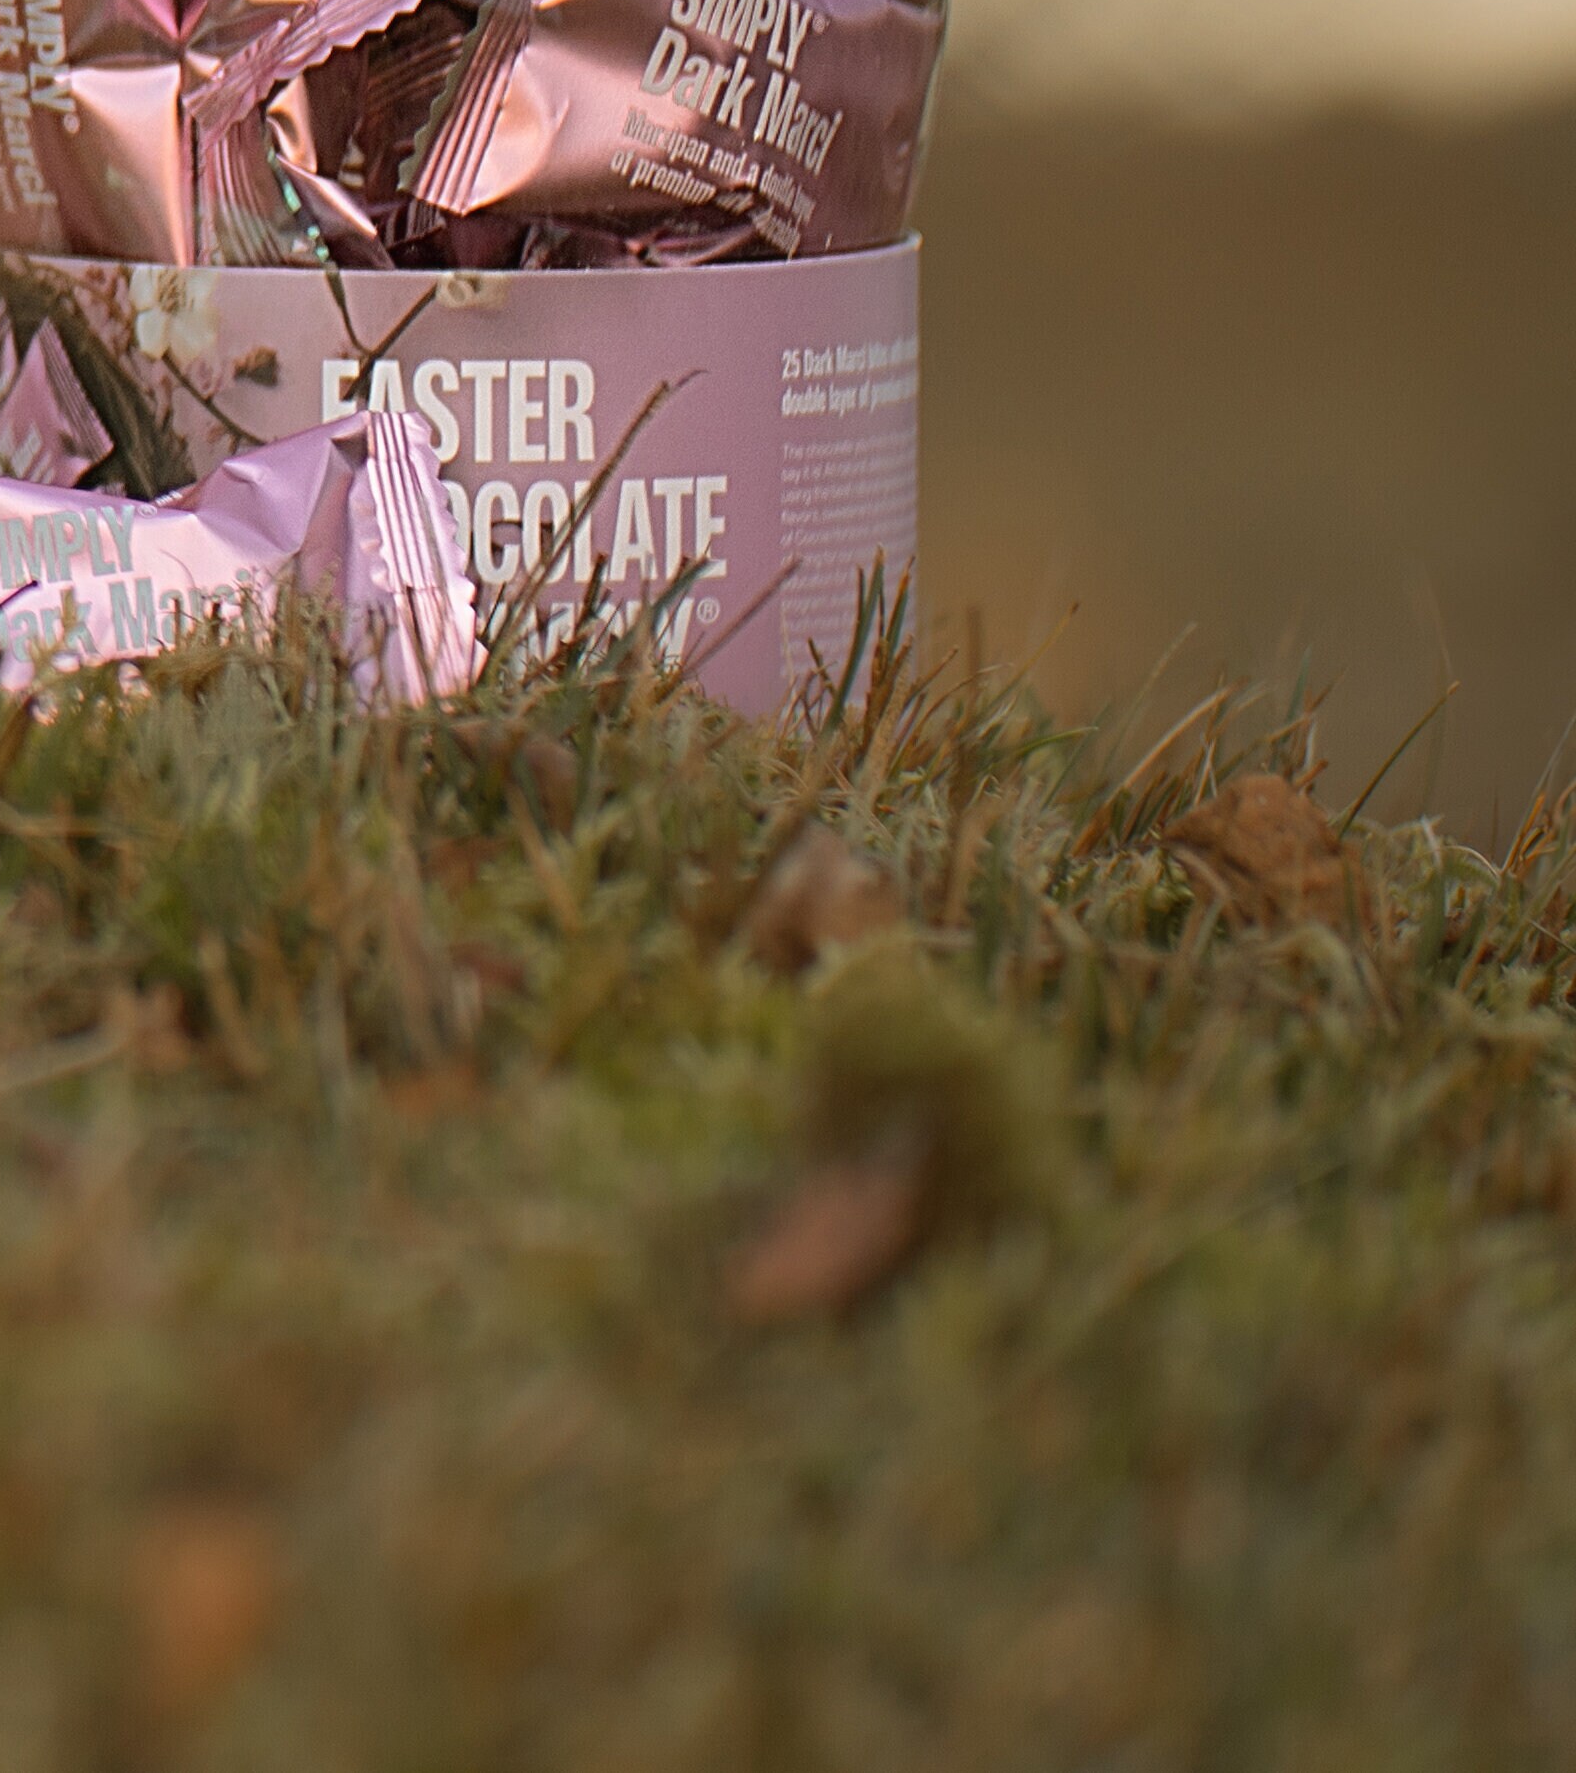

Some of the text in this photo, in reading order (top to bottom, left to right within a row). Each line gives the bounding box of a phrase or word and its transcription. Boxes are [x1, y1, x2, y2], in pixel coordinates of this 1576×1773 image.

[639, 26, 756, 130] Dark
[708, 146, 748, 178] and
[782, 348, 801, 380] 25
